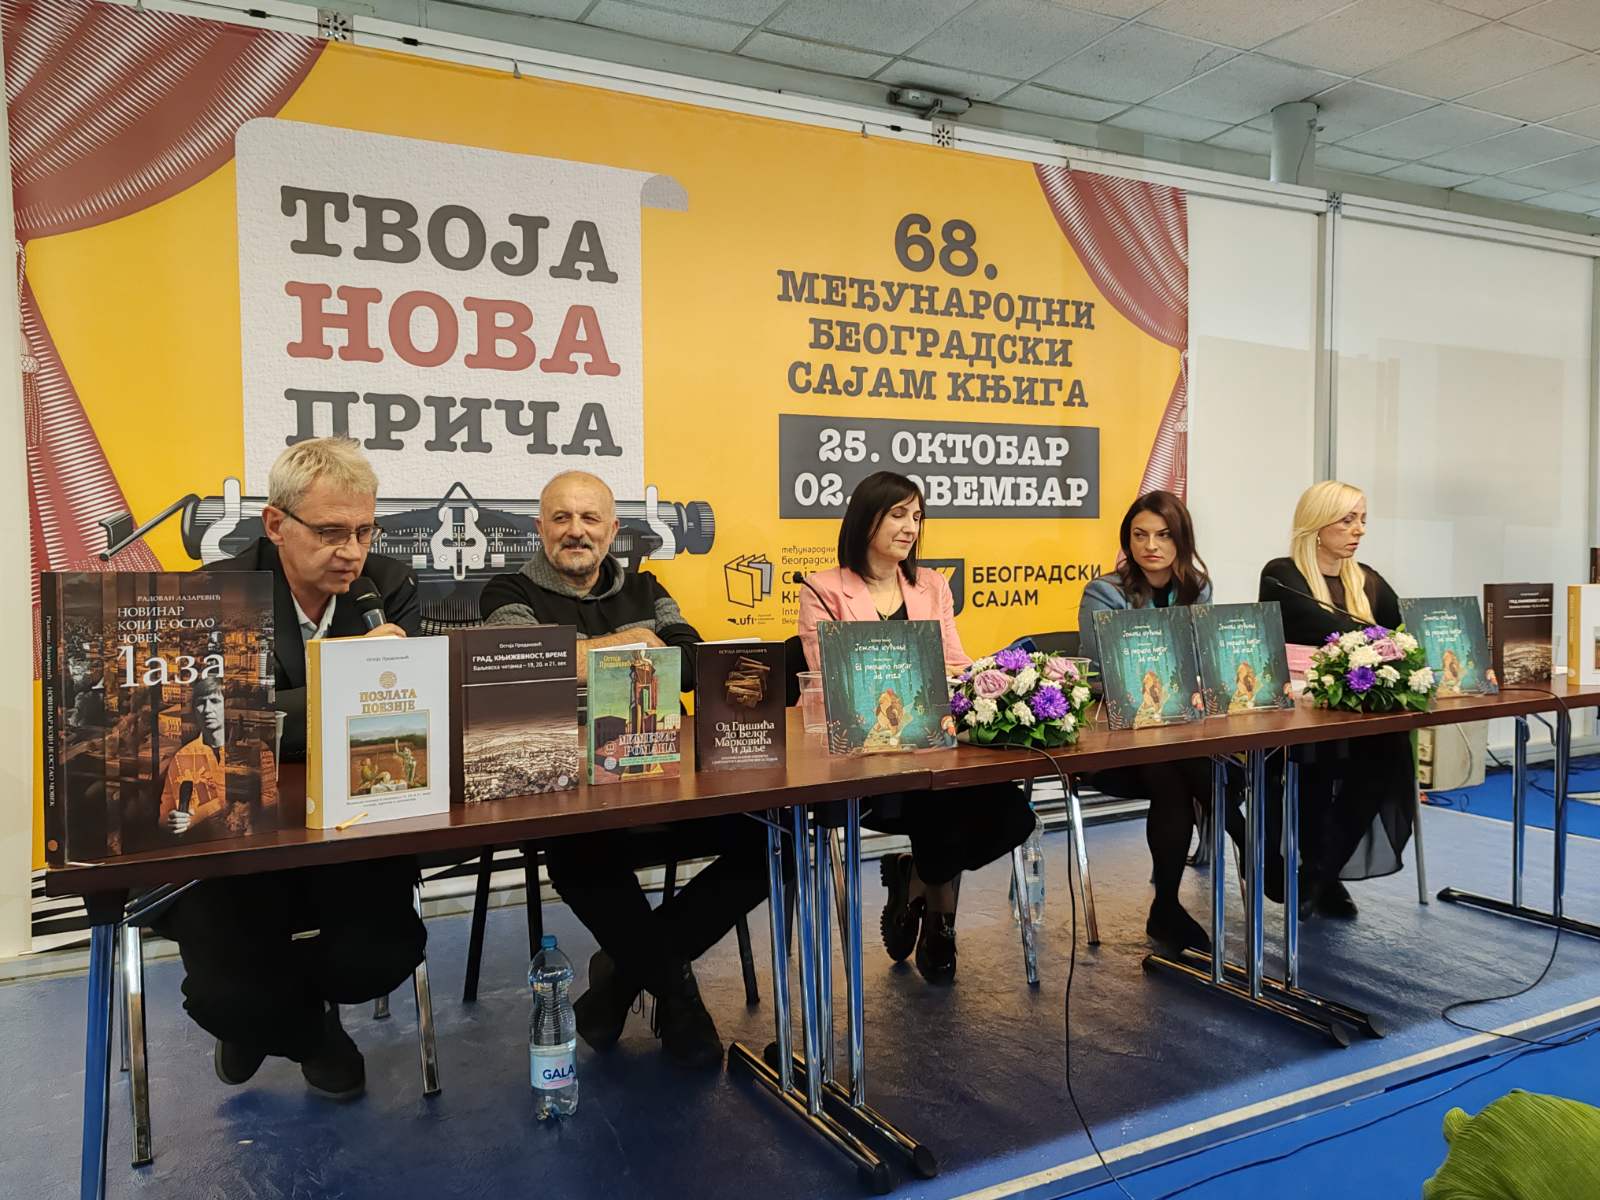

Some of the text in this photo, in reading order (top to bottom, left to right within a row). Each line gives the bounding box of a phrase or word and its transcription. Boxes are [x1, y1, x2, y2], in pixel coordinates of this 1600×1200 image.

[281, 185, 619, 284] ТВОЈА
[894, 213, 998, 280] 68.
[777, 270, 1096, 331] МЕЂУНАРОДНИ
[284, 281, 621, 377] НОВА
[808, 317, 1073, 368] БЕОГРАДСКИ
[787, 361, 1089, 408] САЈАМ КЊИГА
[284, 388, 623, 457] ПРИЧА
[818, 428, 1070, 466] 25. ОКТОБАР
[972, 565, 1100, 584] БЕОГРАДСКИ
[972, 589, 1038, 608] САЈАМ
[117, 606, 185, 617] НОВИНАР
[118, 618, 215, 631] КОЈИ ЈЕ ОСТАО
[118, 632, 162, 644] ЧОВЕК
[359, 688, 417, 702] ПОЗЛАТА
[362, 700, 416, 713] ПОЕЗИЈЕ
[715, 721, 731, 732] Од
[725, 731, 737, 740] до
[542, 1065, 574, 1079] GALA
